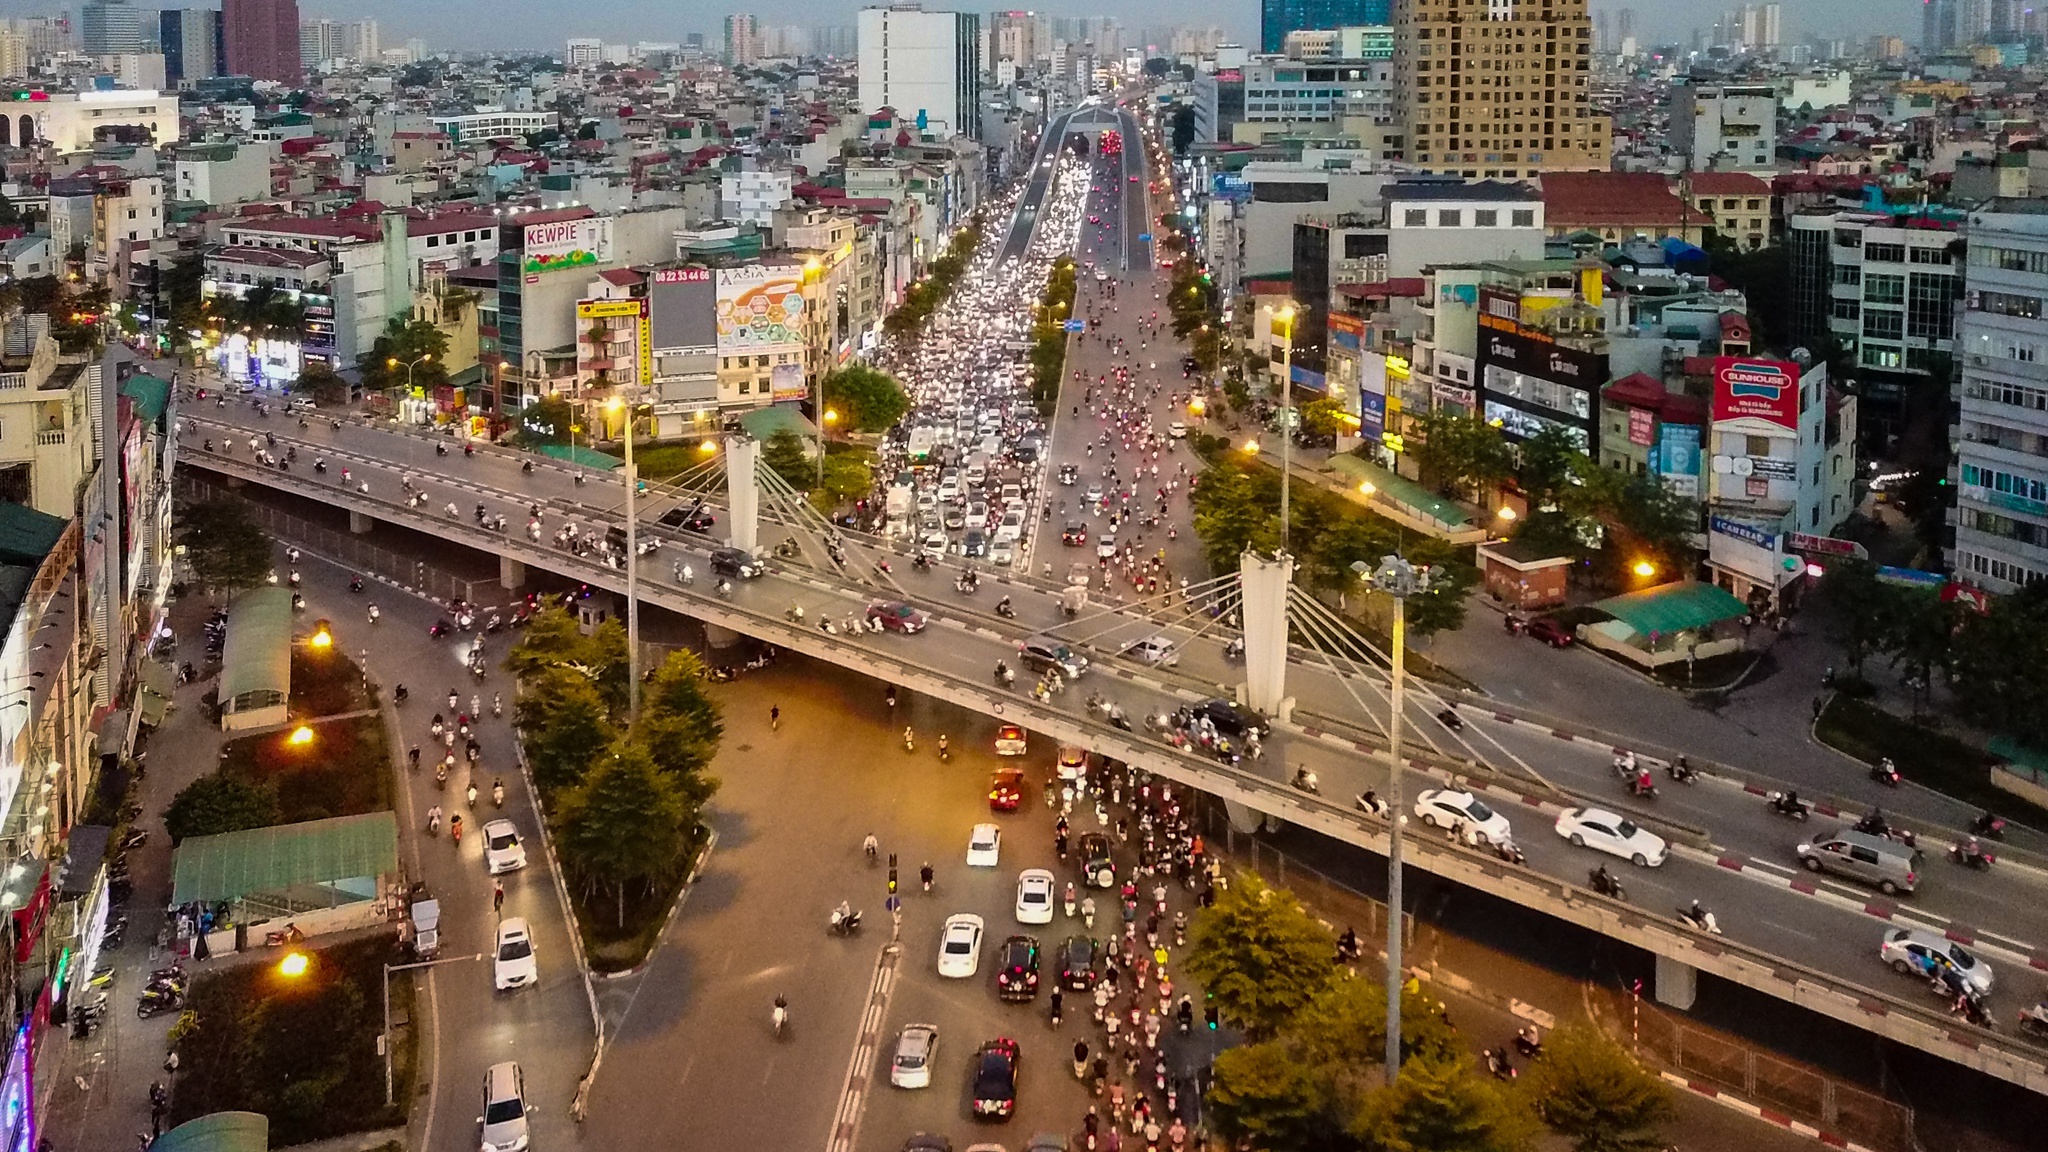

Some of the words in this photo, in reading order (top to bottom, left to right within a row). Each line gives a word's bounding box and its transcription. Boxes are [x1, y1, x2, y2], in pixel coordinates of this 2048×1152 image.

[527, 224, 577, 246] KEWPIE
[666, 271, 677, 282] 22
[677, 270, 687, 281] 33
[688, 270, 699, 280] 44
[733, 271, 764, 280] ASIA
[1728, 372, 1785, 385] SUNHOUSE
